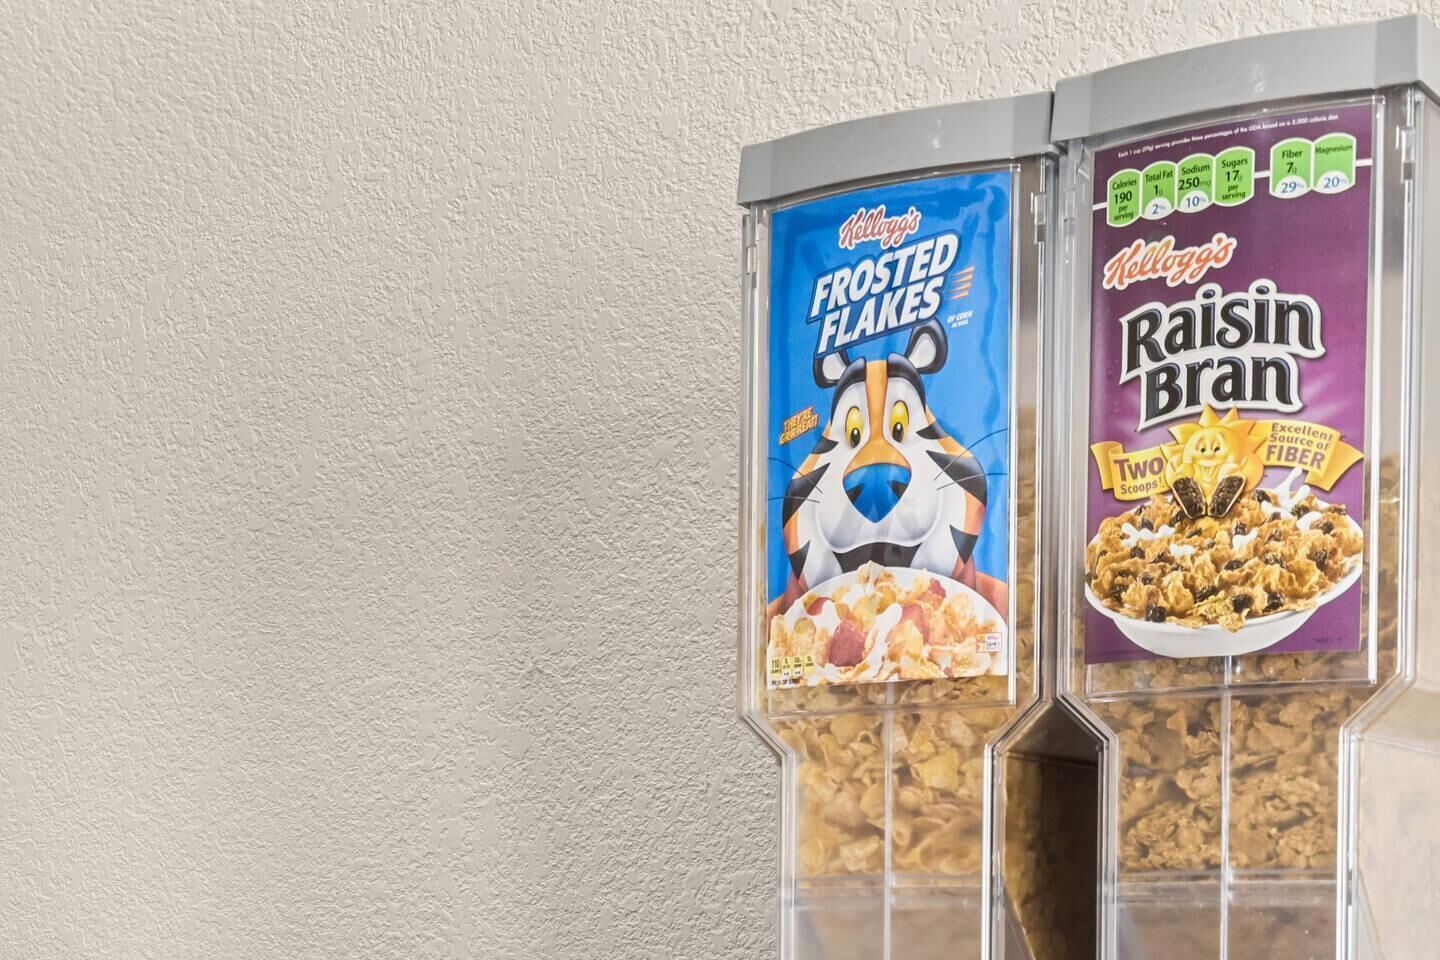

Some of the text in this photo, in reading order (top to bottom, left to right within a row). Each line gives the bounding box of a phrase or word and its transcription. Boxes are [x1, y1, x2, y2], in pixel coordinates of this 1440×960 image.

[1281, 149, 1304, 160] Fiber
[1314, 144, 1353, 156] Magnesium
[1181, 164, 1211, 176] Sodium
[1221, 158, 1249, 170] Sugars
[1286, 161, 1298, 175] 7g
[1144, 170, 1174, 182] Total Fat
[1112, 178, 1138, 191] Calories
[1227, 184, 1240, 194] per
[1113, 190, 1134, 204] 190
[1221, 191, 1247, 201] serving
[1117, 204, 1129, 214] per
[1113, 211, 1135, 222] serving
[839, 206, 921, 249] Kellogg's
[1104, 233, 1236, 289] Kellogg's
[810, 233, 960, 318] FROSTED
[817, 276, 943, 354] FLAKES
[1123, 283, 1321, 375] Raisin
[1143, 354, 1295, 424] Bran
[1271, 422, 1335, 442] Excellent
[1269, 432, 1330, 451] Source of
[1265, 444, 1327, 471] FIBER
